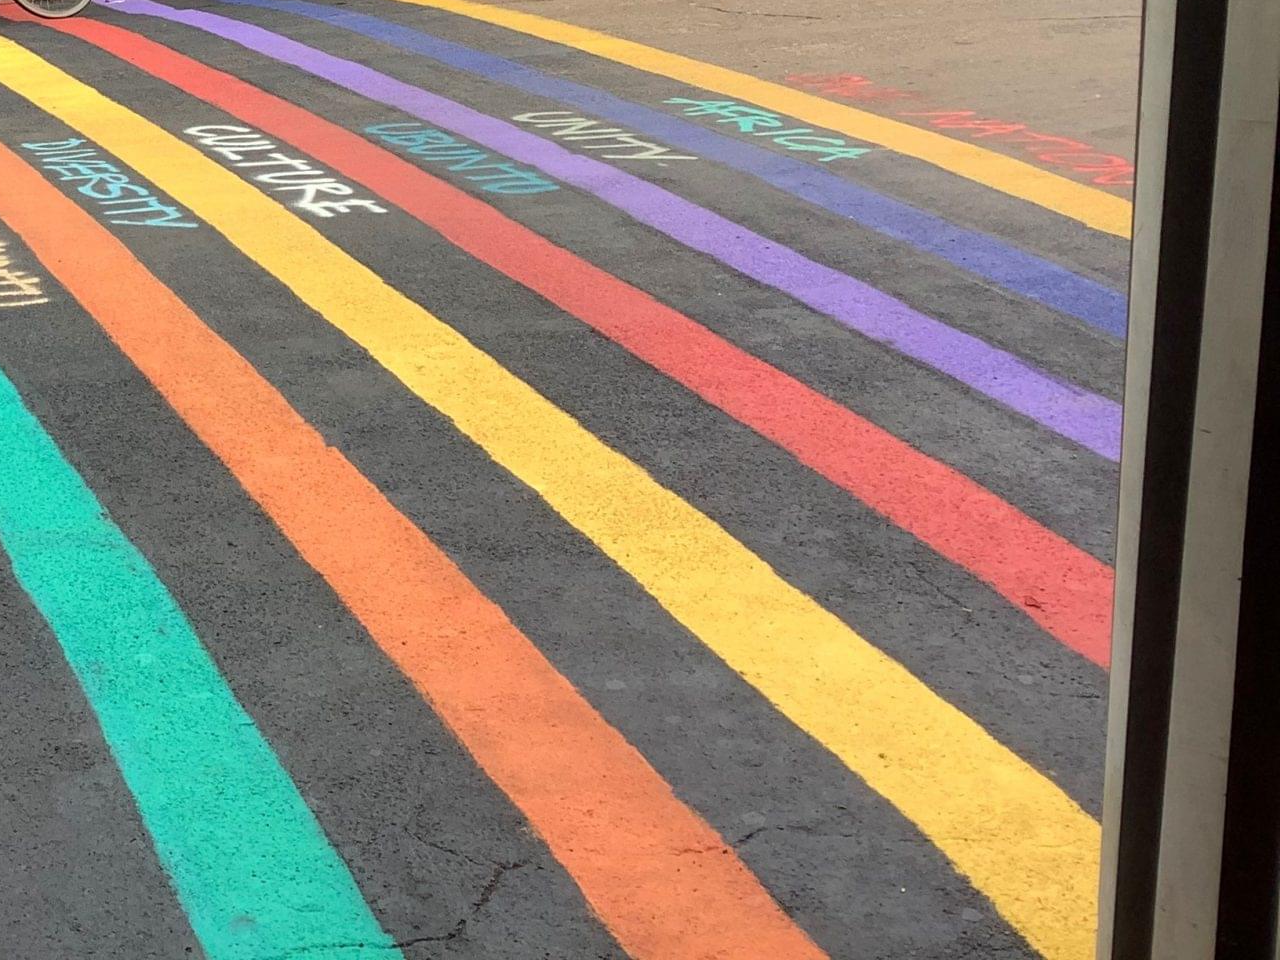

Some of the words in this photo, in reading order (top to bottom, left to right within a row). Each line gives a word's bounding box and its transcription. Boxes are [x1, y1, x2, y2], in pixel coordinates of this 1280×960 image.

[181, 123, 389, 219] CULTURE
[662, 97, 873, 162] AFRICA
[21, 138, 200, 228] DIVERSITY
